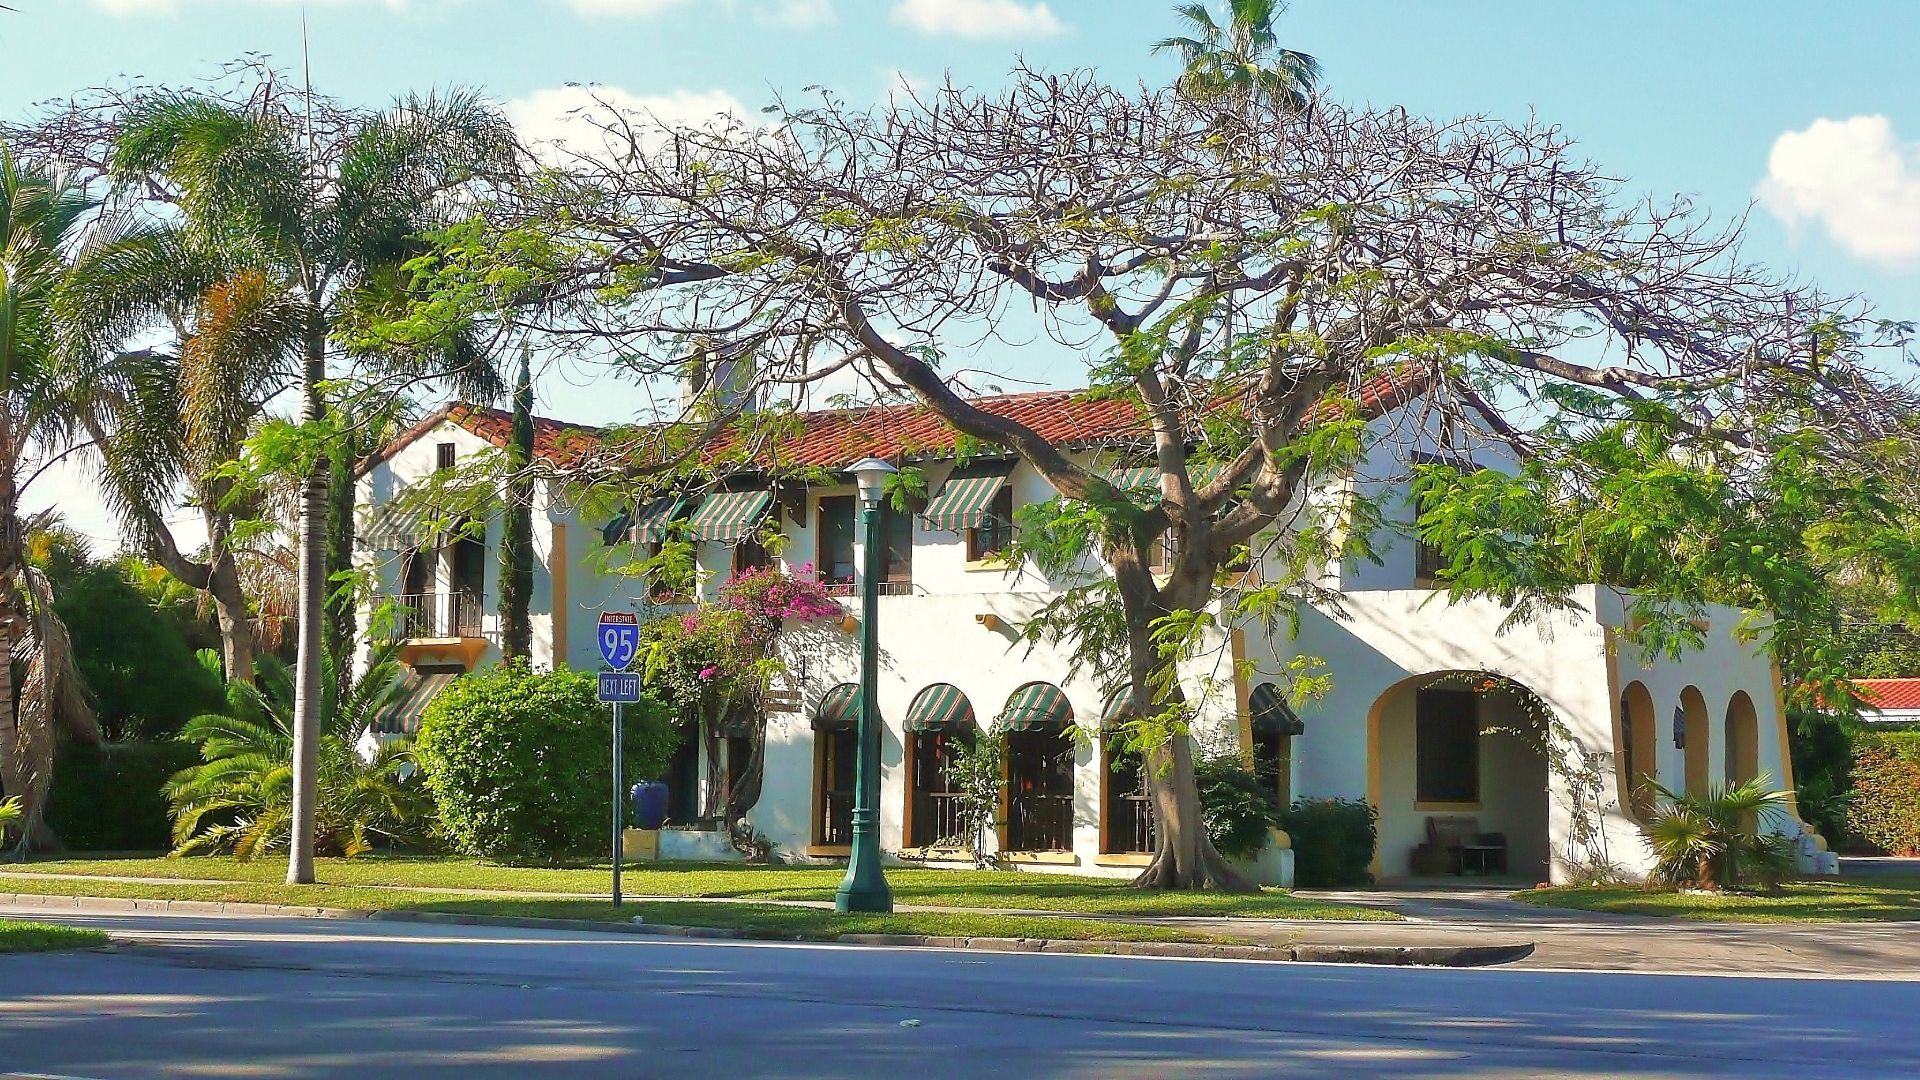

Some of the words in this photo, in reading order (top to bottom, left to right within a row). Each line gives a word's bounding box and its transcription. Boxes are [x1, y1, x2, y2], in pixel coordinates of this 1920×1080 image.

[604, 615, 633, 623] INTERSTATE
[605, 629, 632, 662] 95
[600, 679, 617, 695] NEXT
[620, 679, 636, 695] LEFT
